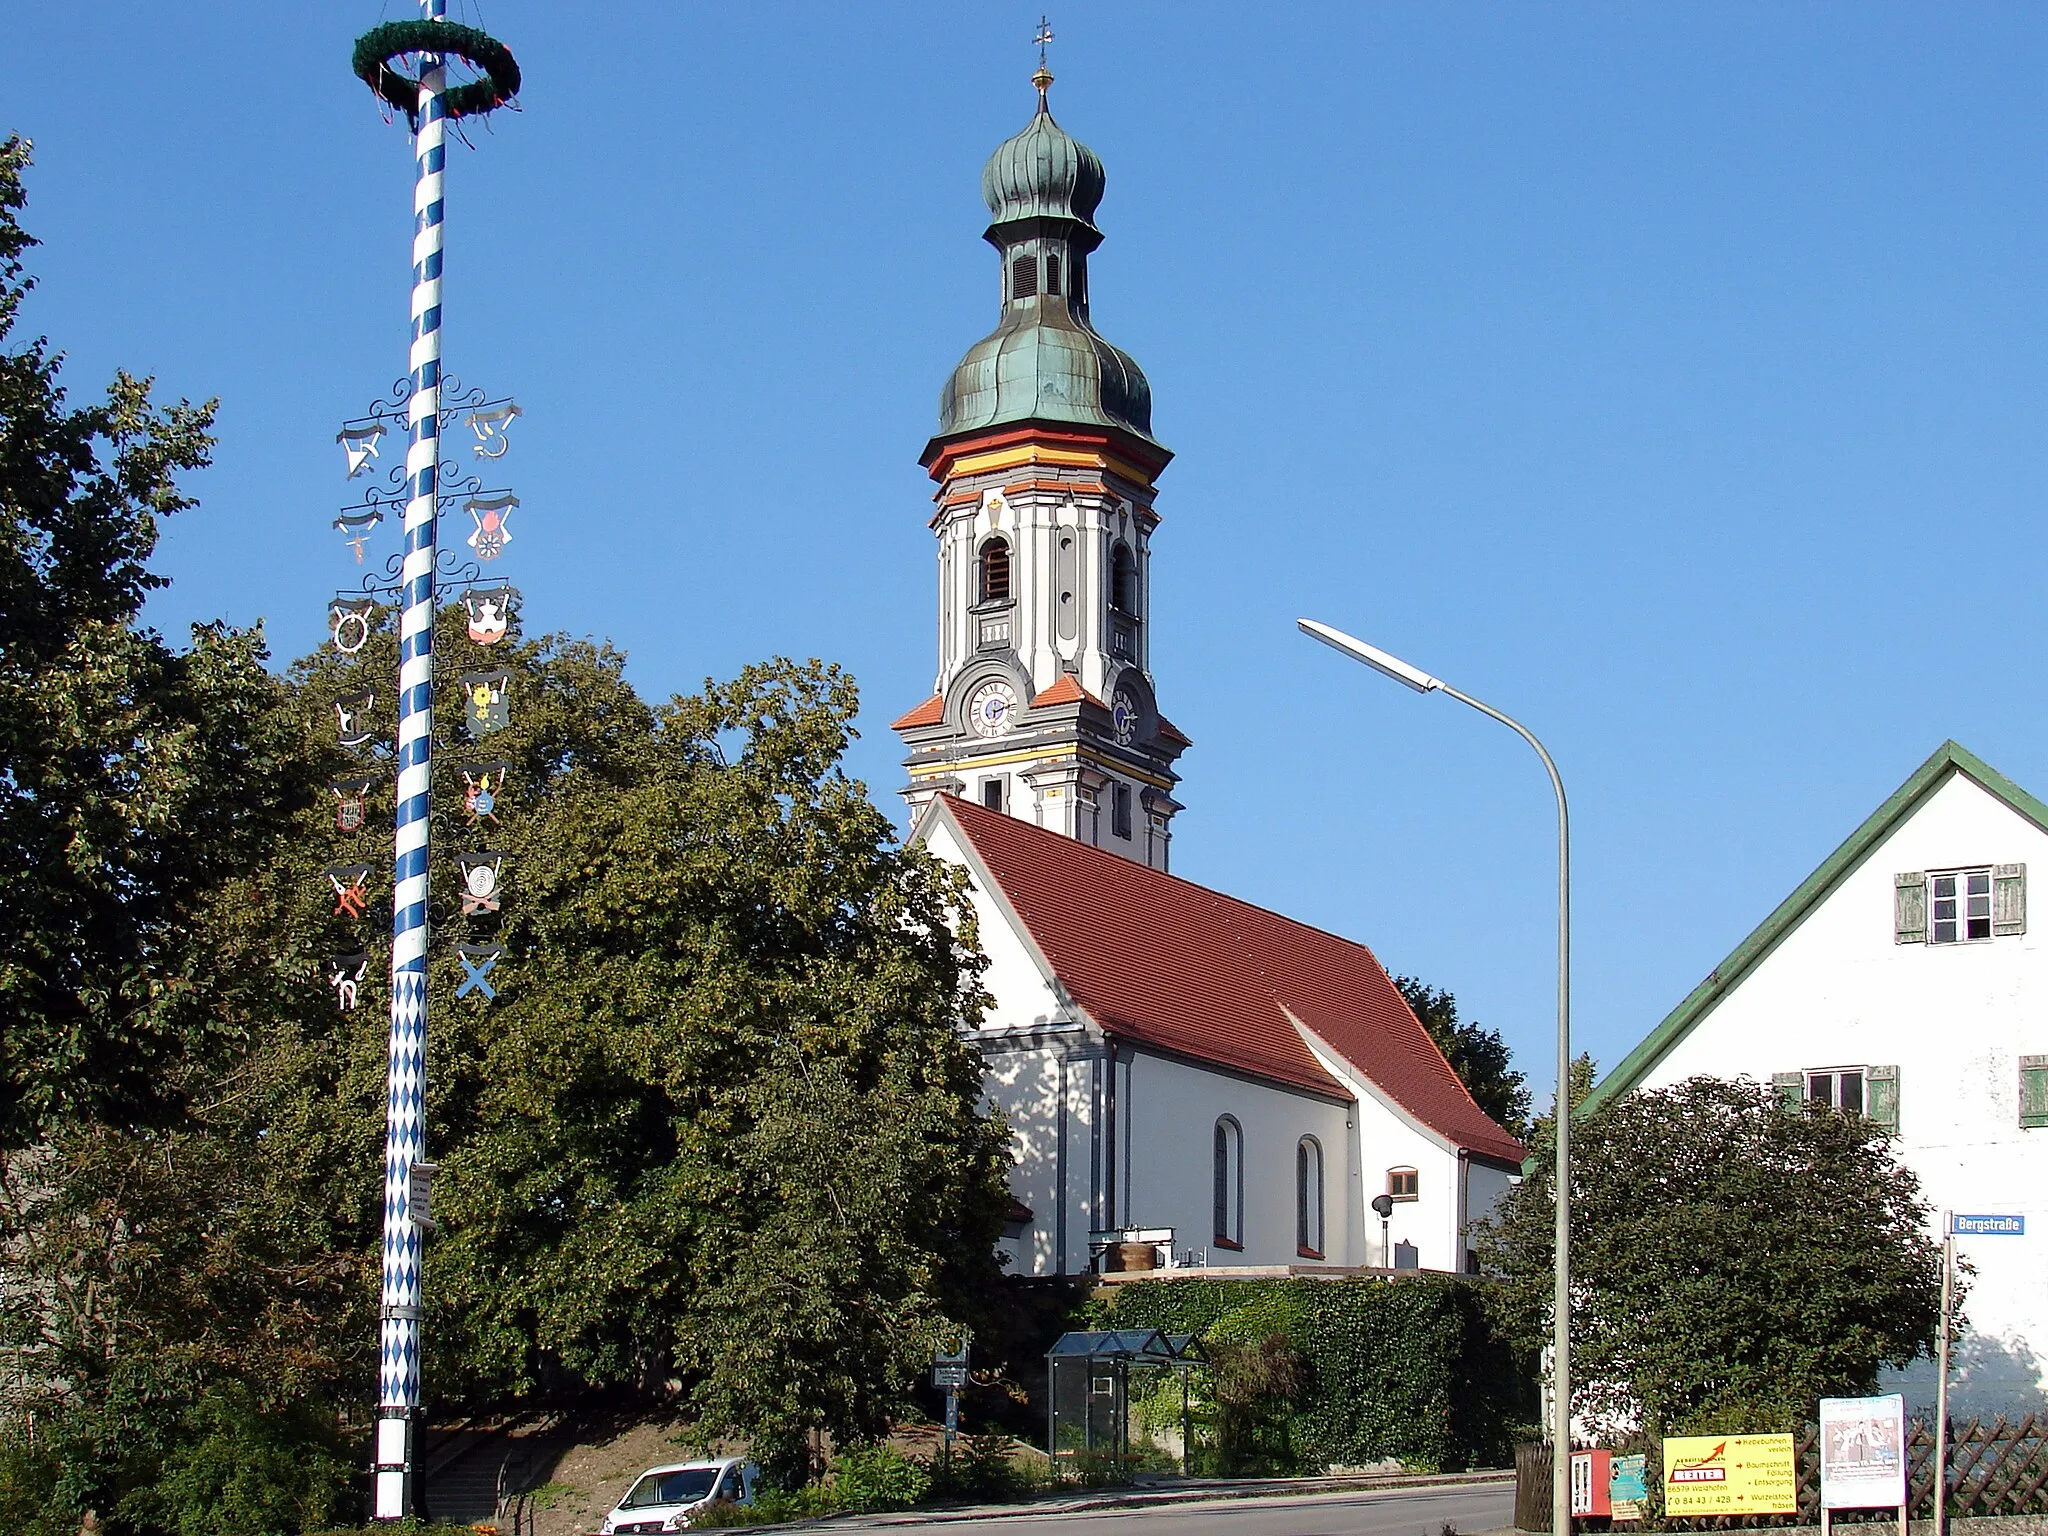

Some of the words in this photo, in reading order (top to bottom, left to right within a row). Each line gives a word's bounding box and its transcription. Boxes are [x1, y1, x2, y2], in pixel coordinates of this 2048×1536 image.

[1958, 1216, 2020, 1233] Bergstraße
[1674, 1469, 1724, 1480] REITER
[1667, 1485, 1690, 1493] 86579
